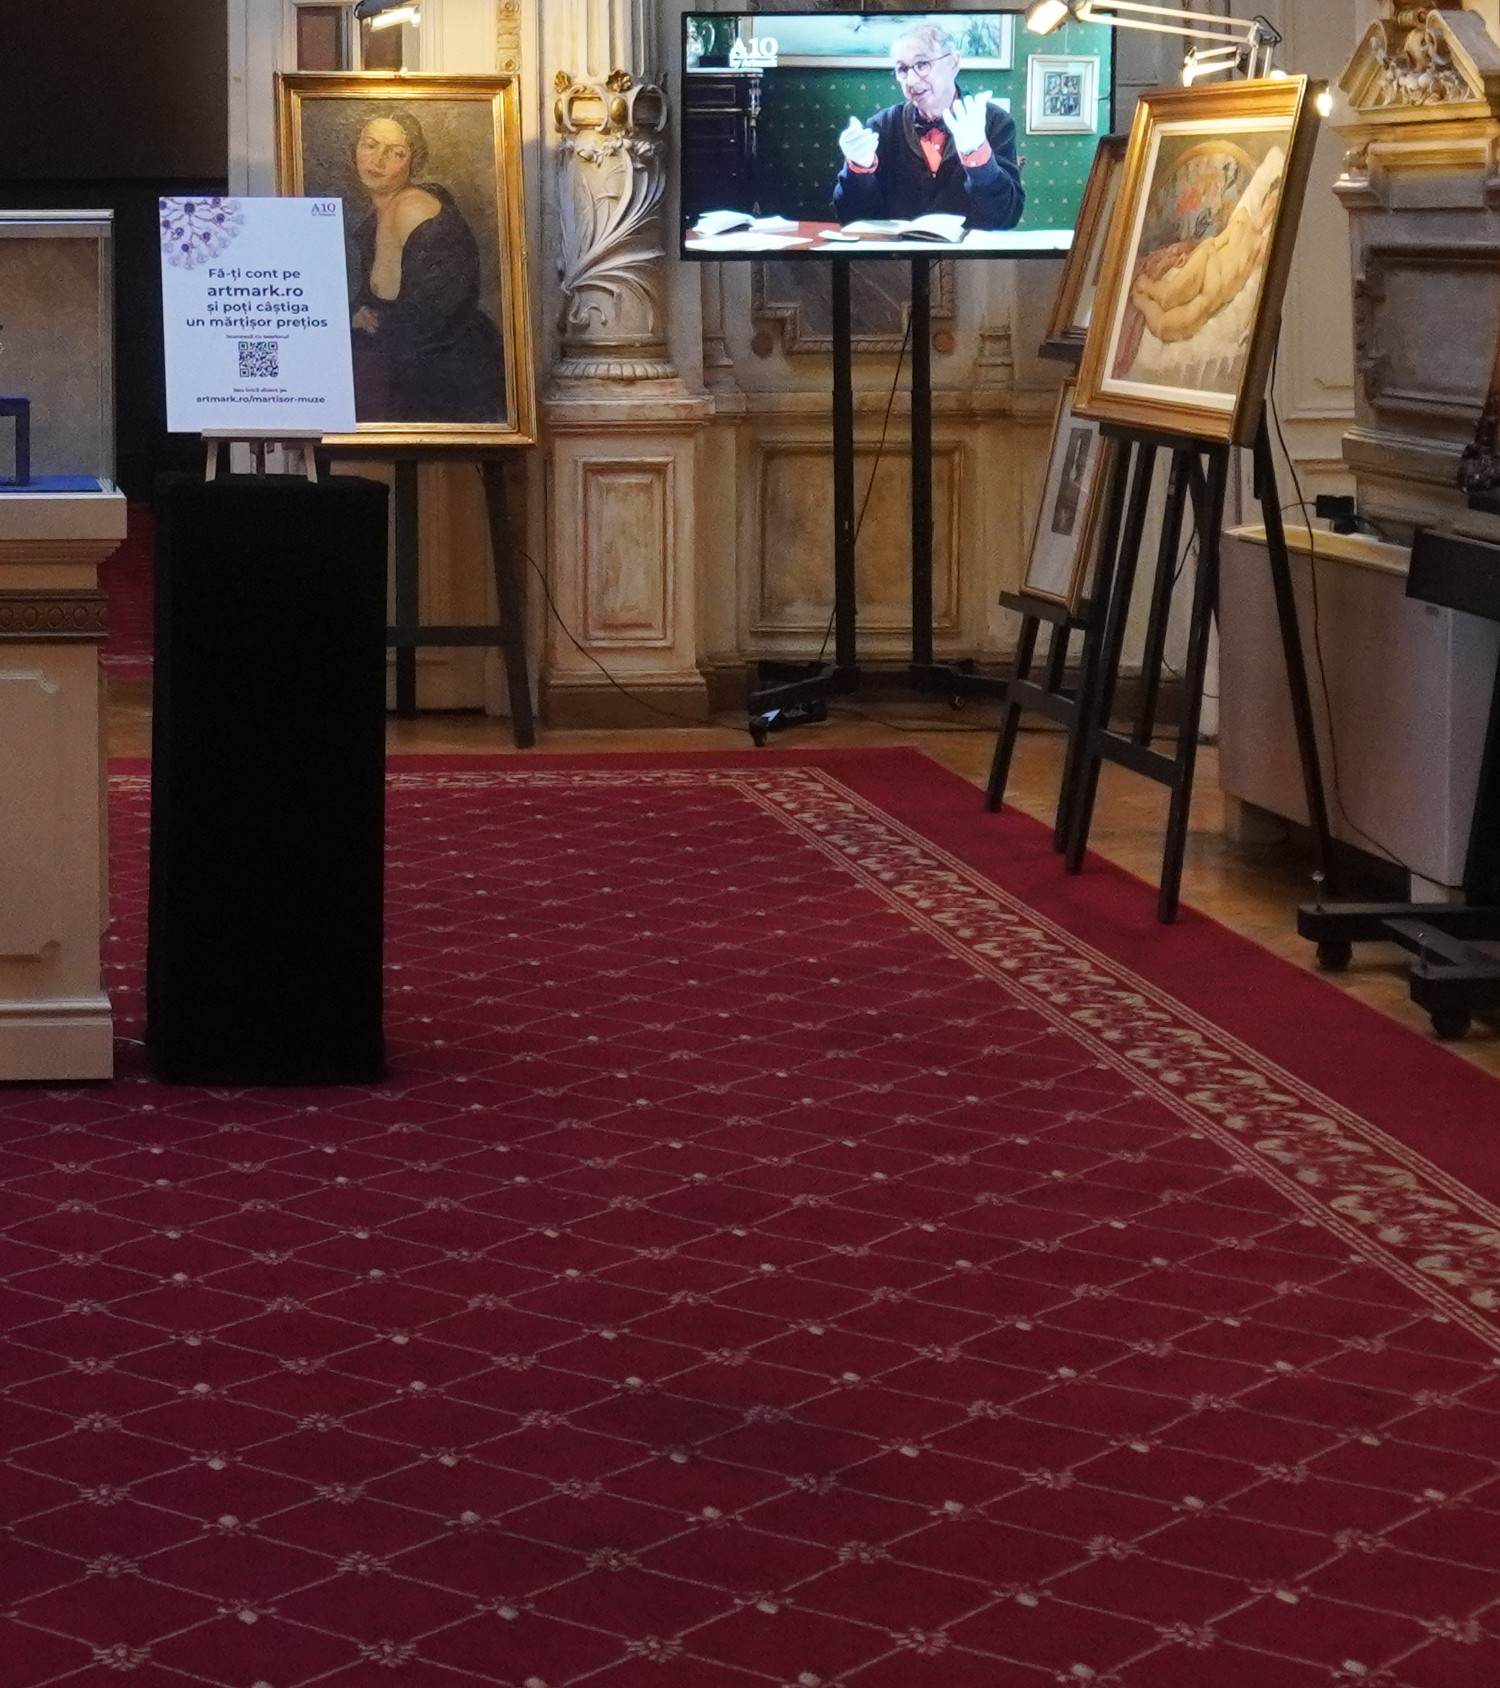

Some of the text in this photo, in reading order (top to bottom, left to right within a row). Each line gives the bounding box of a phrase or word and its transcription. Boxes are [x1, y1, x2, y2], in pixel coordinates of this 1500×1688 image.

[730, 37, 779, 57] A10
[246, 269, 278, 279] cont
[283, 270, 301, 280] pe
[207, 284, 304, 297] artmark.ro
[223, 301, 252, 314] poți
[256, 301, 309, 315] câștiga
[186, 316, 328, 330] un mărțișor prețios
